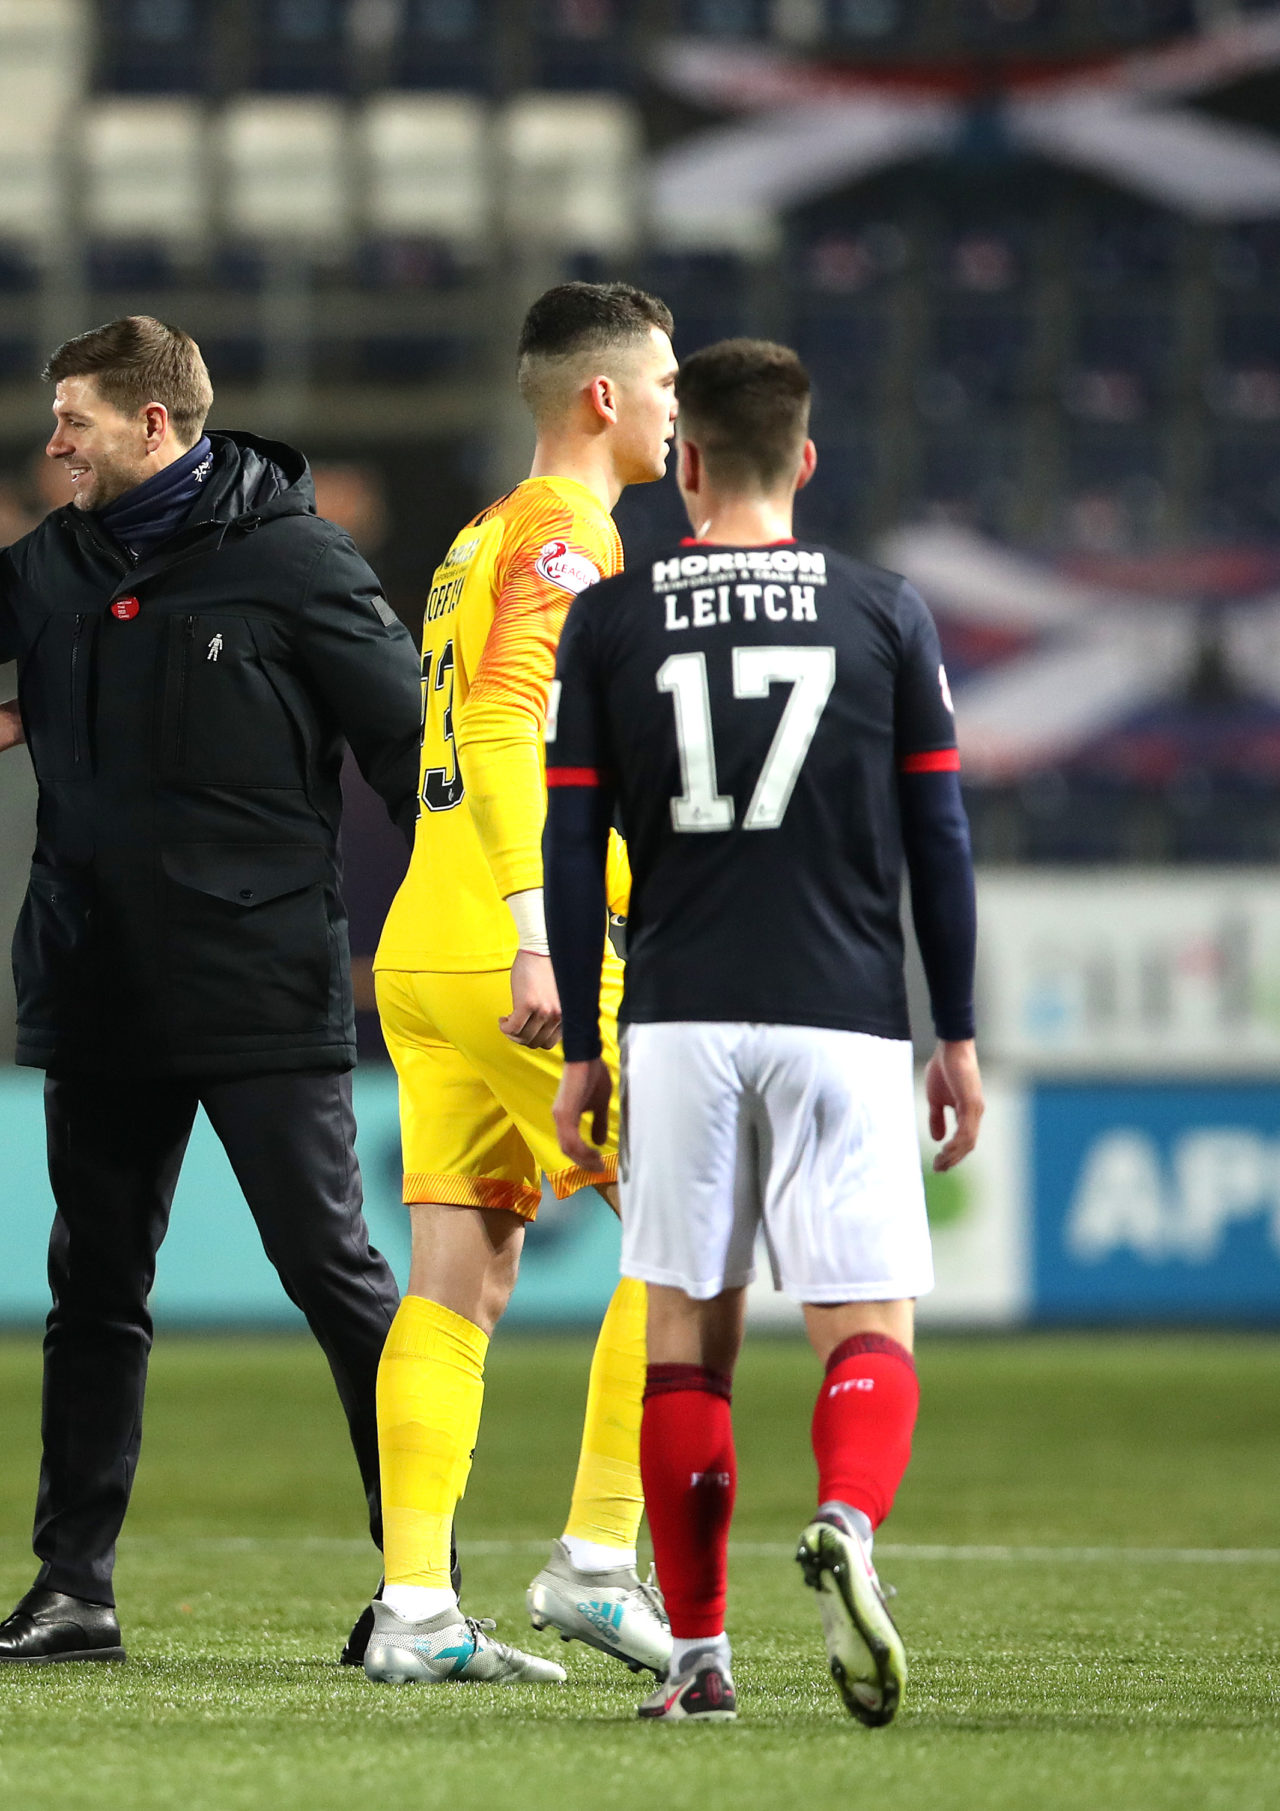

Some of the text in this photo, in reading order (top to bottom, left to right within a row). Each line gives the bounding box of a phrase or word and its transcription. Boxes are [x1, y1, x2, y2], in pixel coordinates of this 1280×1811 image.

[652, 550, 827, 583] HORIZON
[665, 584, 818, 631] LEITCH
[656, 646, 836, 833] 17
